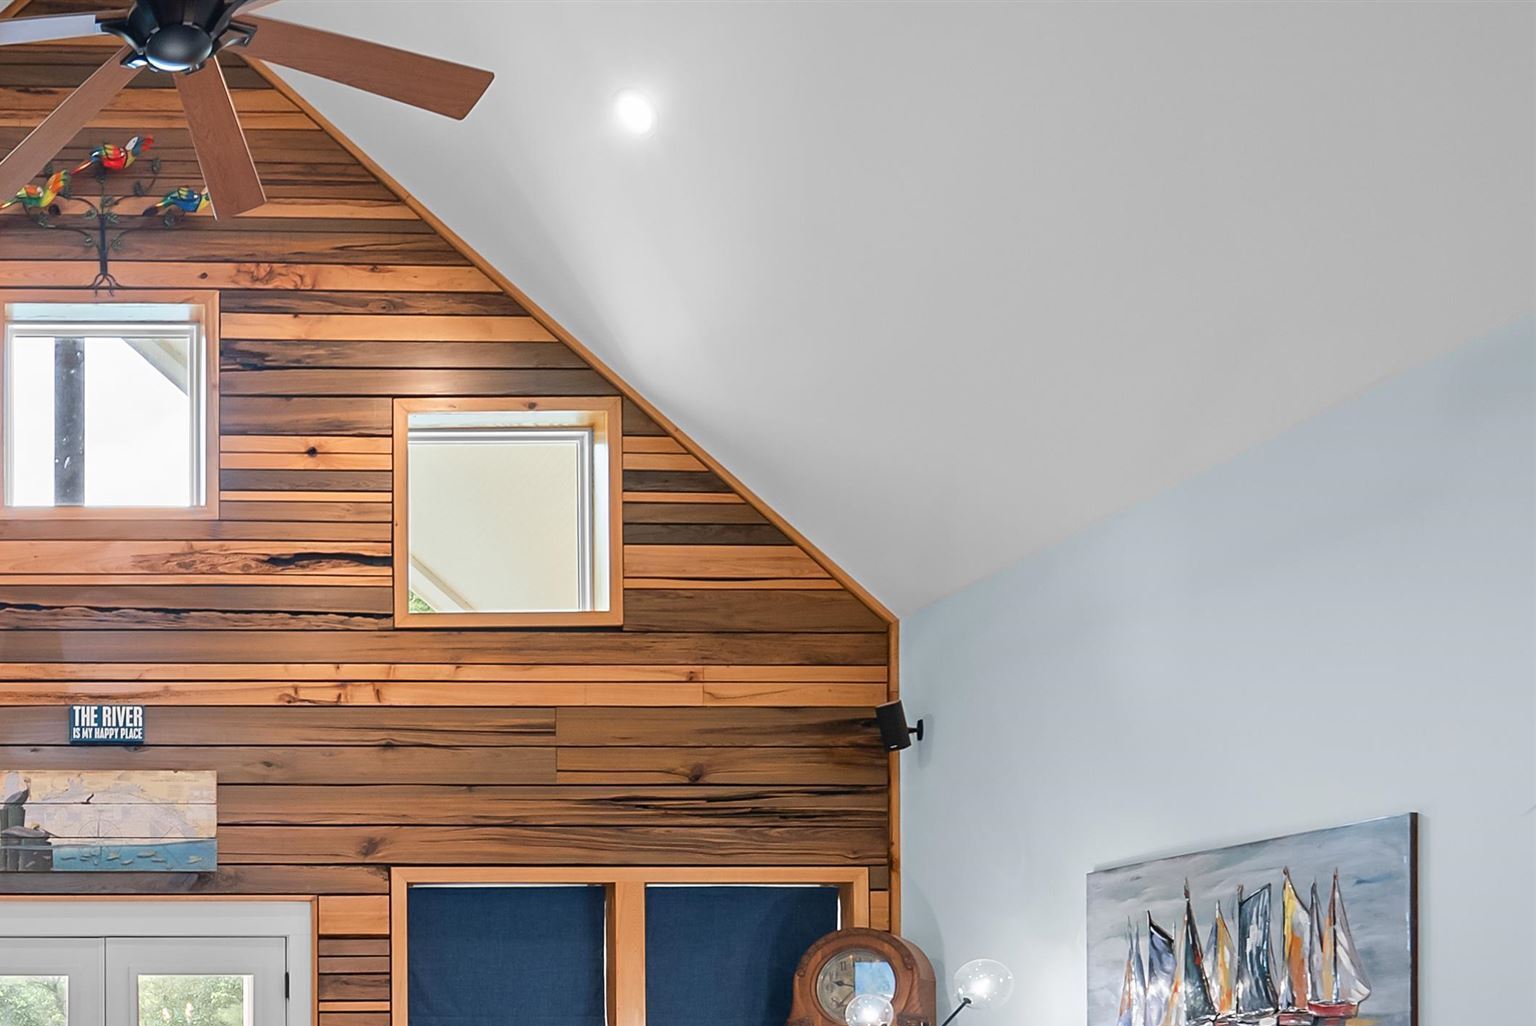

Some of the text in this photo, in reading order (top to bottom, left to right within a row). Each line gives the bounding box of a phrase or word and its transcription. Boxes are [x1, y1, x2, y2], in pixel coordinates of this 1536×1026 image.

[72, 705, 143, 727] THE RIVER
[72, 728, 143, 739] IS MY HAPPY PLACE
